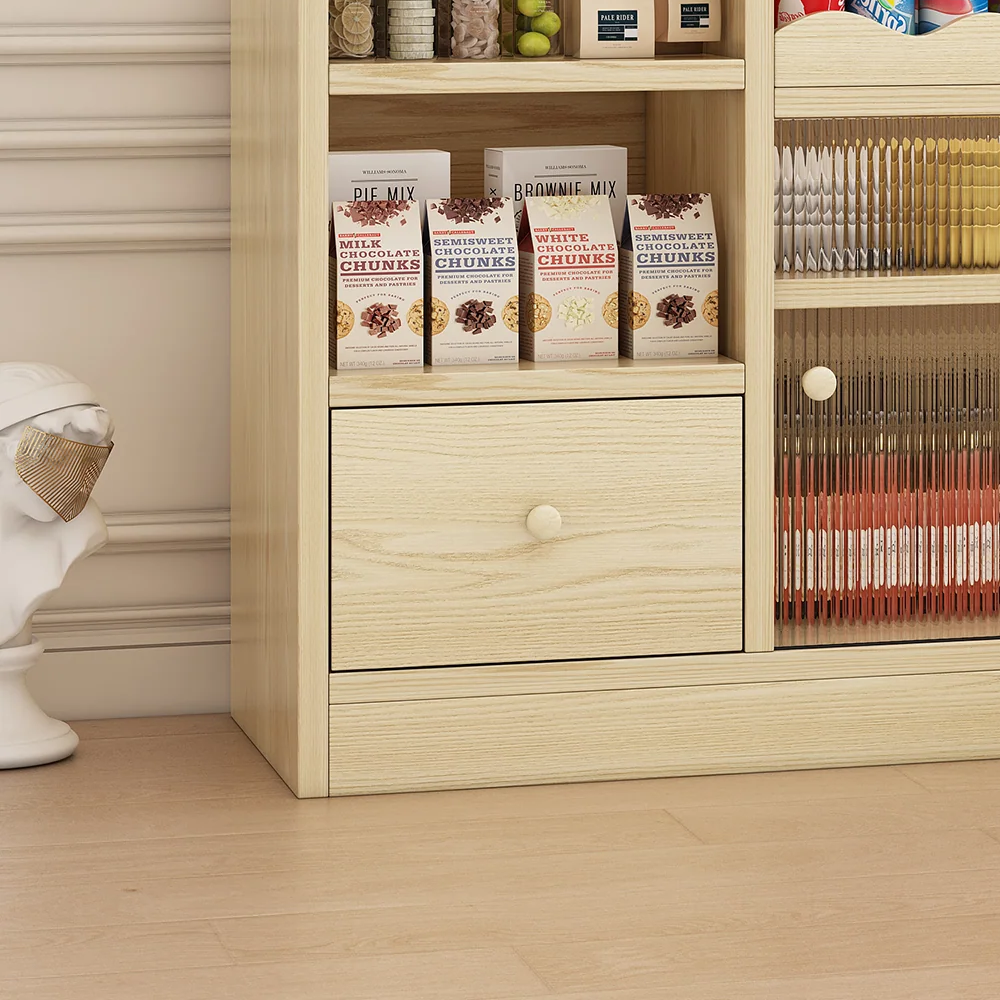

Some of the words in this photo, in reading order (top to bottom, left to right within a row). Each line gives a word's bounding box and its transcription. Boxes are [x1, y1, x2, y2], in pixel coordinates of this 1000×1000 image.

[354, 187, 378, 201] PIE
[387, 186, 415, 201] MIX
[514, 181, 582, 202] BROWNIE
[591, 181, 617, 198] MIX
[433, 237, 514, 246] SEMISWEET
[535, 234, 589, 243] WHITE
[635, 233, 713, 241] SEMISWEET
[339, 240, 382, 249] MILK
[537, 244, 615, 252] CHOCOLATE
[636, 242, 714, 250] CHOCOLATE
[340, 250, 420, 258] CHOCOLATE
[435, 247, 515, 255] CHOCOLATE
[537, 253, 615, 265] CHUNKS
[636, 251, 715, 263] CHUNKS
[340, 260, 420, 272] CHUNKS
[435, 256, 516, 268] CHUNKS
